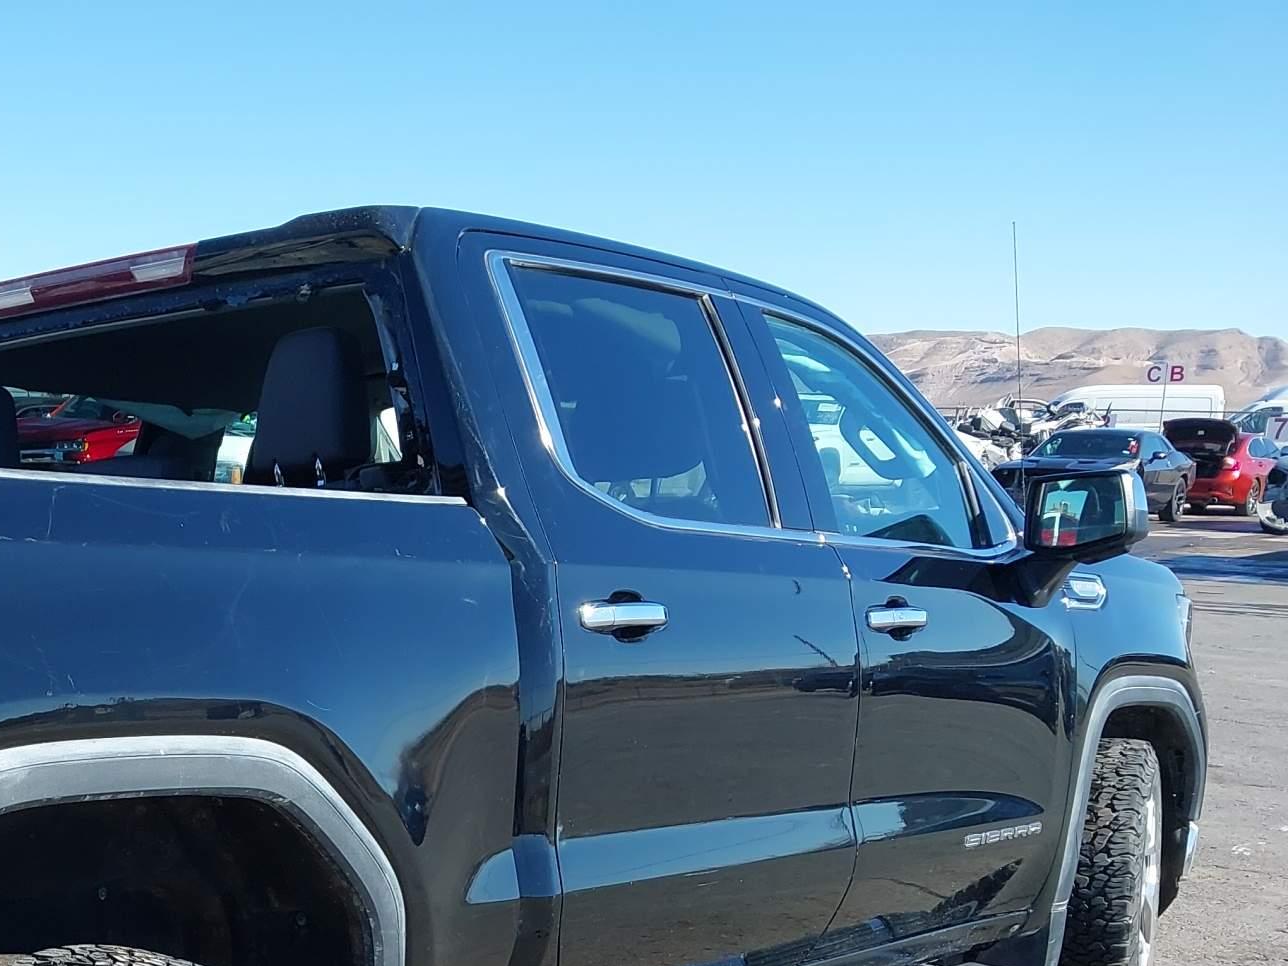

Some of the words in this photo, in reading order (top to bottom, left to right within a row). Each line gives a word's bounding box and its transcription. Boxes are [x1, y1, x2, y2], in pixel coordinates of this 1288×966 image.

[1147, 366, 1161, 382] C
[1170, 366, 1185, 382] B
[964, 821, 1043, 848] SIERRA
